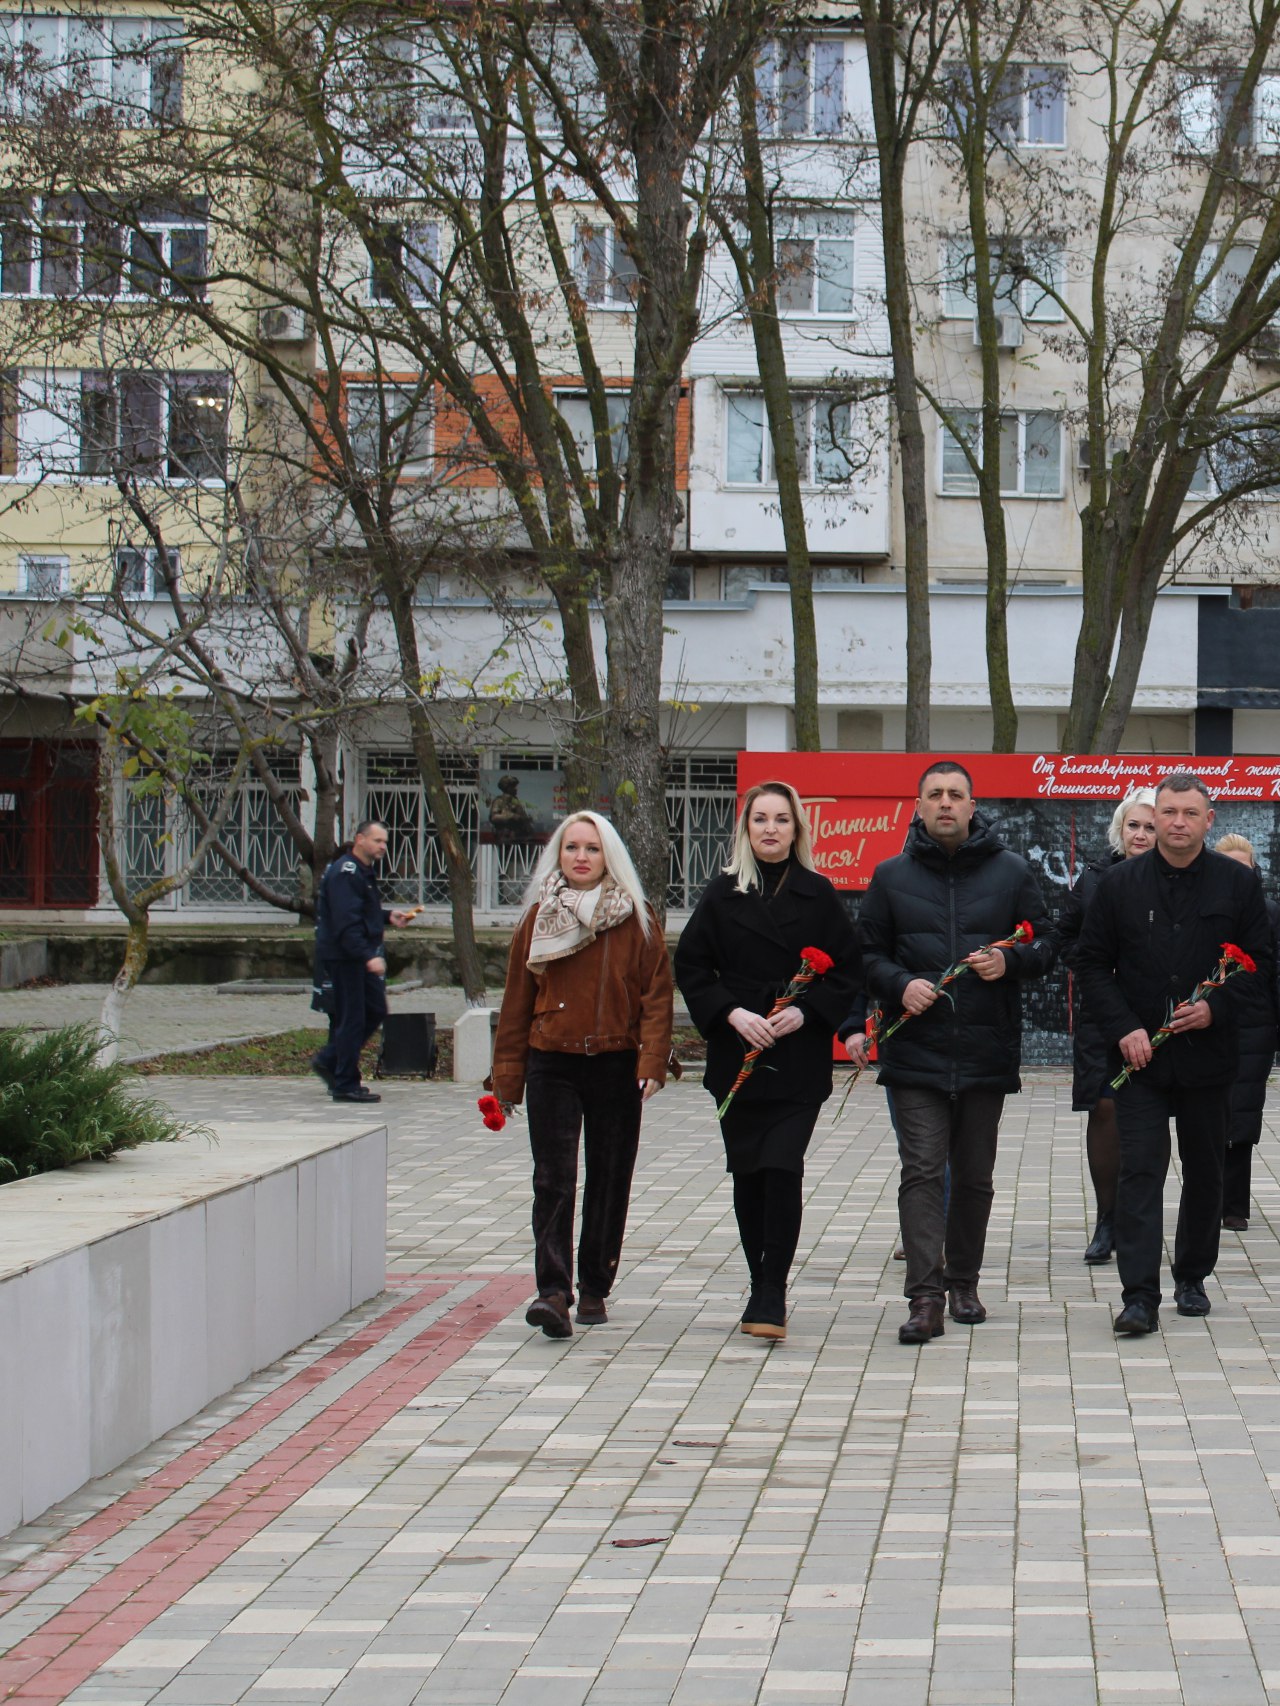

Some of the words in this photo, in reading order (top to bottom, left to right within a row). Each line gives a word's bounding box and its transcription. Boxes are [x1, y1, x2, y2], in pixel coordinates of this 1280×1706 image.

[1032, 755, 1054, 774] От
[1060, 756, 1152, 779] благодарных
[1157, 760, 1233, 776] потомков
[1038, 776, 1121, 796] Ленинского
[801, 797, 902, 843] Помним!
